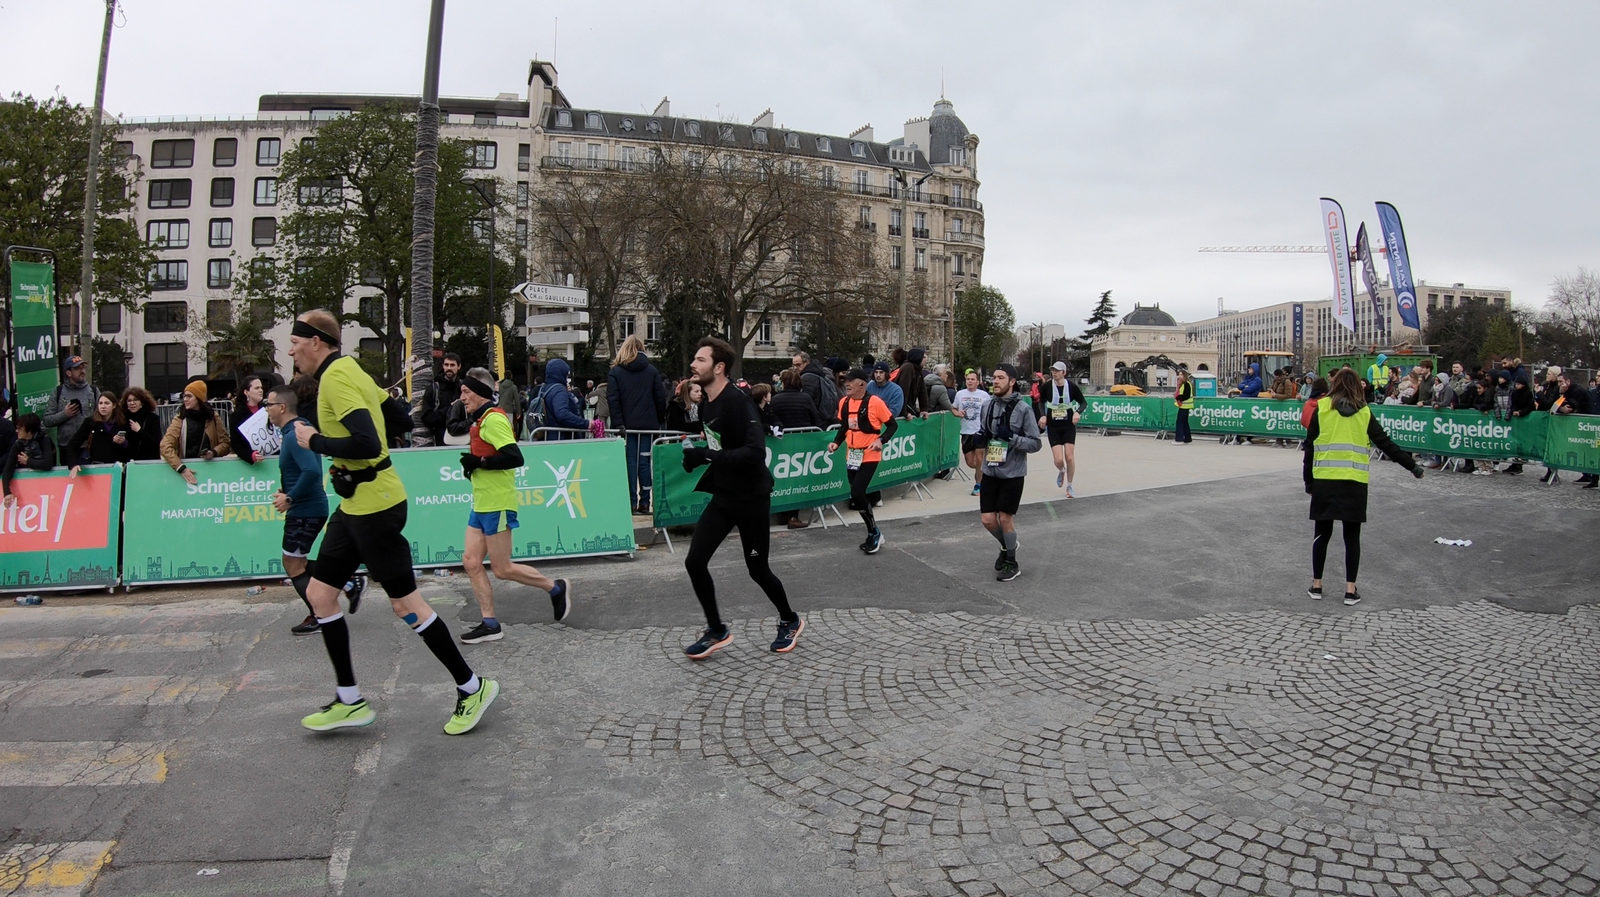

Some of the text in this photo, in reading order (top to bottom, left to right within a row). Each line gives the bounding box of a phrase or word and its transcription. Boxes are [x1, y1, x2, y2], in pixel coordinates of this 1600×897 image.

[18, 334, 54, 362] Km 42
[1092, 401, 1141, 415] Schneider
[1251, 405, 1302, 420] Schneid
[1112, 415, 1141, 423] Electric
[1211, 419, 1244, 427] Electric
[1376, 413, 1427, 432] hneider
[1433, 417, 1512, 438] Schneider
[1392, 430, 1426, 443] Electric
[1464, 437, 1511, 450] Electric
[882, 434, 916, 461] asics
[773, 450, 834, 479] asics
[187, 476, 275, 495] Schneider
[770, 486, 791, 497] sound
[811, 481, 830, 492] sound
[830, 480, 843, 489] body
[224, 492, 273, 503] Electric
[161, 507, 224, 520] MARATHON
